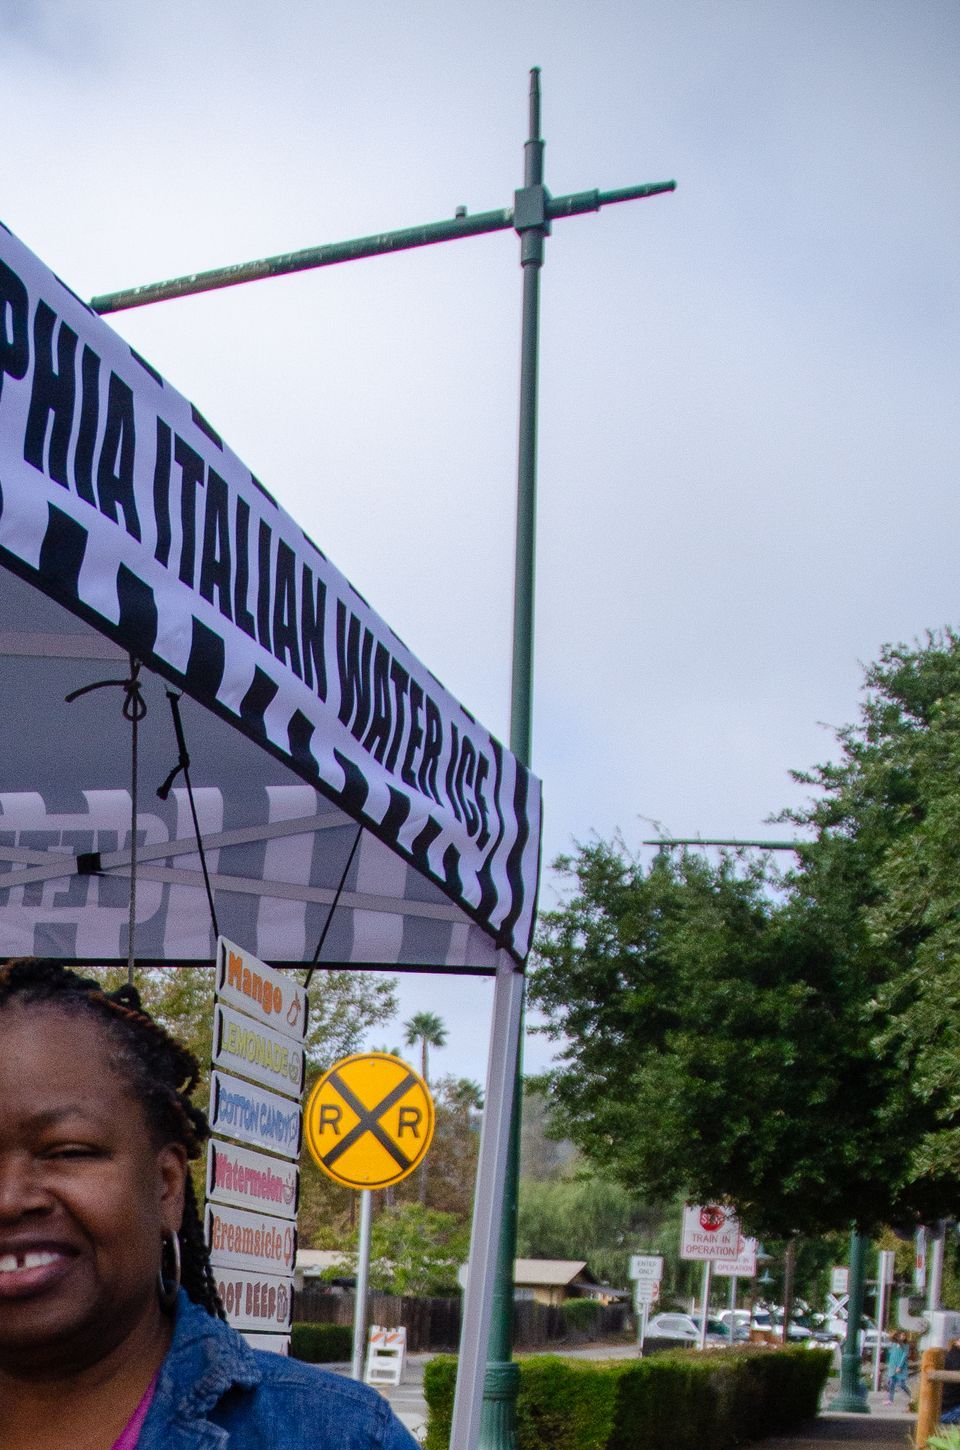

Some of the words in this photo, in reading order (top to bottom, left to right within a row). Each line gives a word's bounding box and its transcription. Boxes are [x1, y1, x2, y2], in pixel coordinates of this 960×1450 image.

[153, 415, 327, 704] ITALIAN
[337, 597, 445, 808] WATER
[449, 720, 491, 847] ICE
[227, 950, 283, 1015] Mango
[221, 1017, 290, 1078] LEMONADE
[219, 1087, 259, 1132] COTTON
[215, 1152, 283, 1204] Watermelon
[213, 1215, 283, 1261] Creamsicle
[686, 1245, 735, 1256] OPERATION
[693, 1233, 718, 1244] TRAIN
[722, 1234, 731, 1244] IN
[717, 1263, 753, 1273] OPERATION
[217, 1281, 243, 1317] OOT
[246, 1282, 276, 1319] BEER
